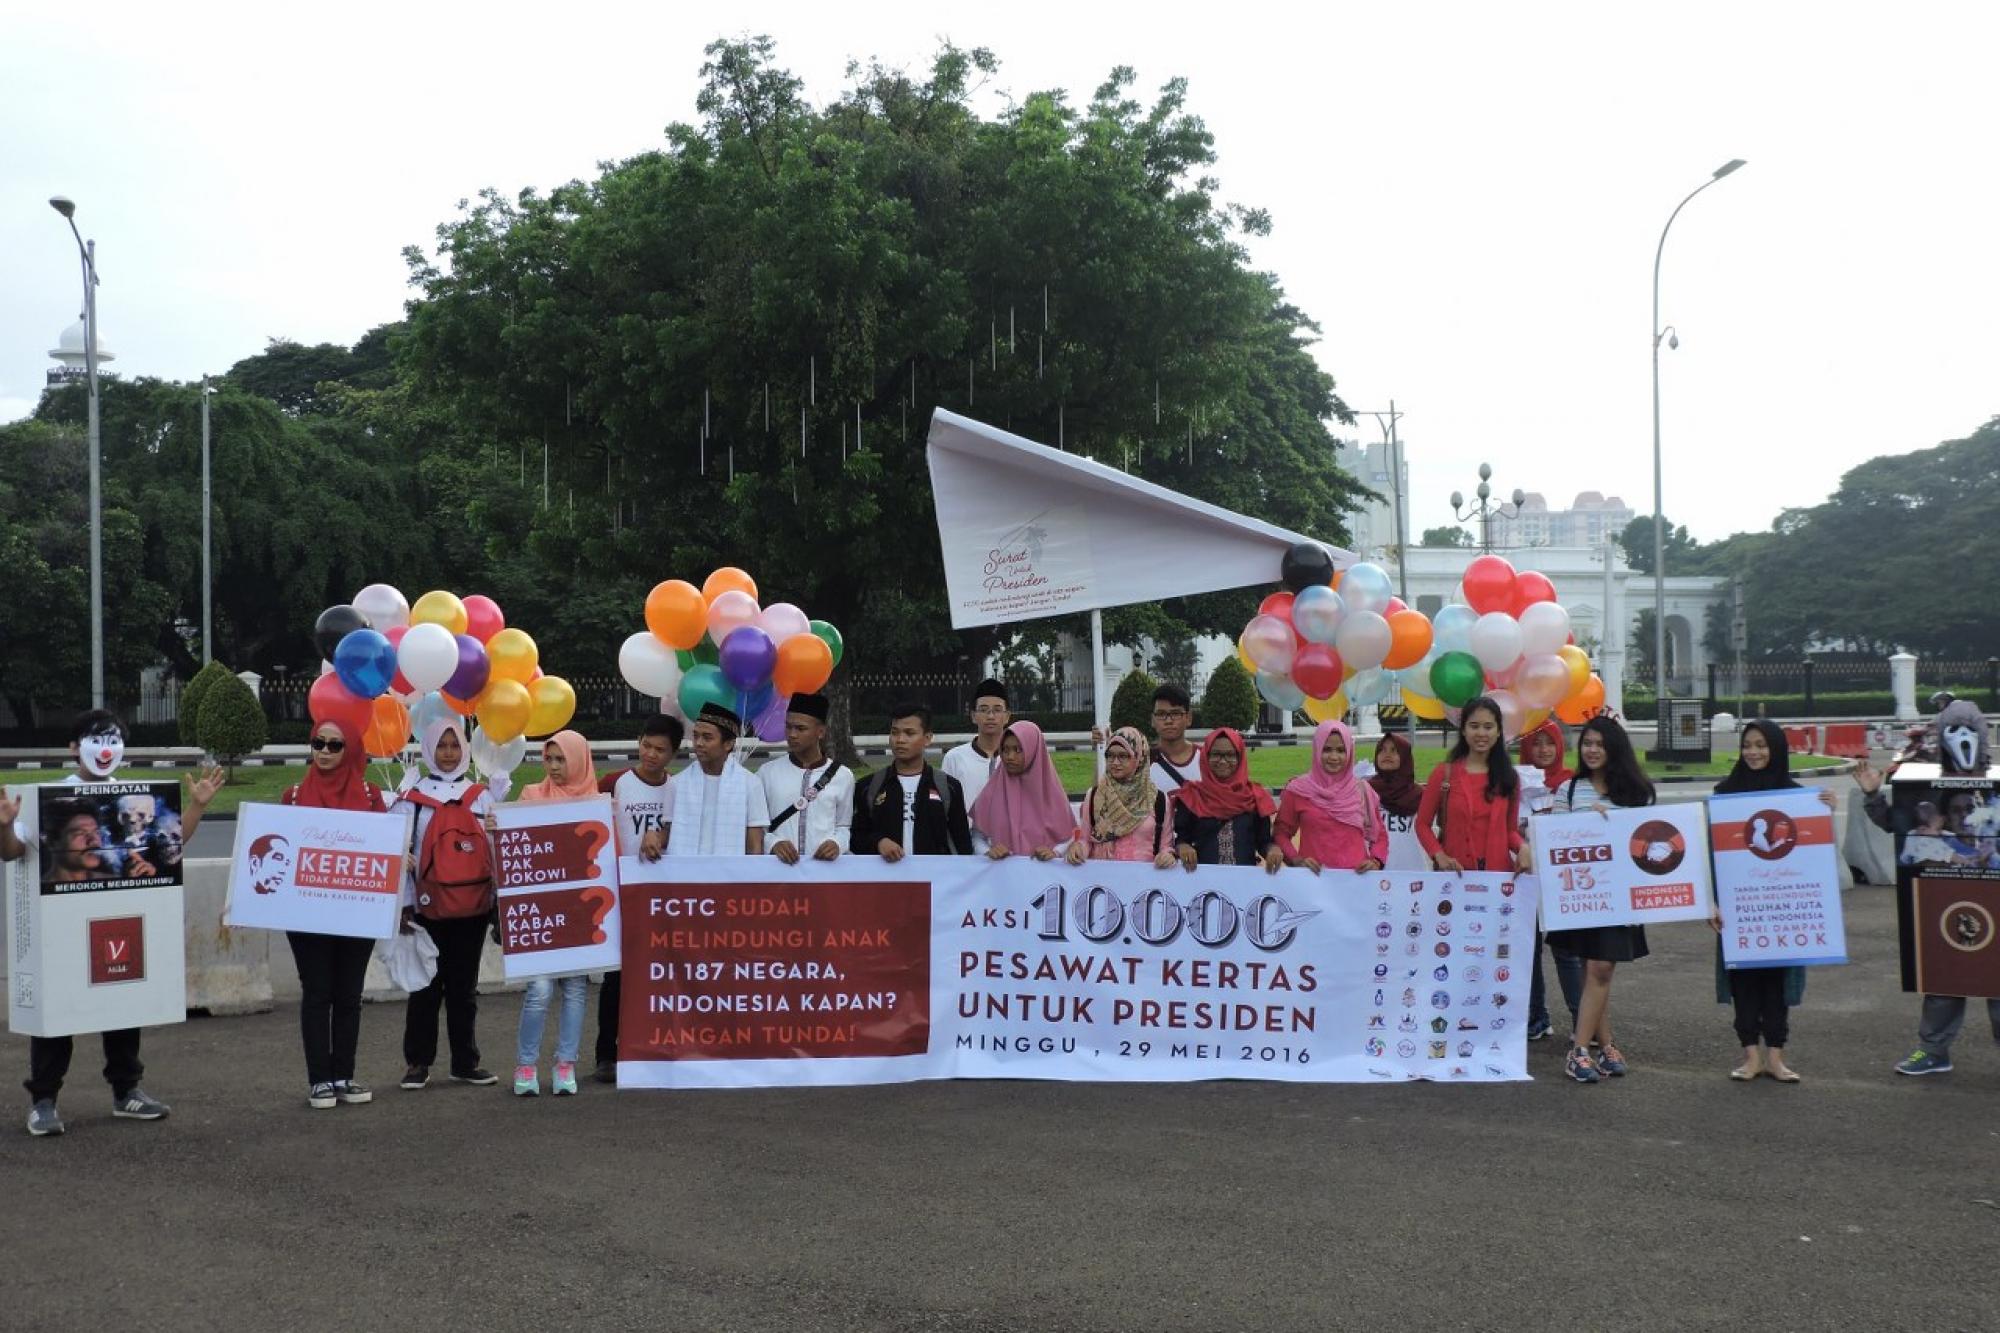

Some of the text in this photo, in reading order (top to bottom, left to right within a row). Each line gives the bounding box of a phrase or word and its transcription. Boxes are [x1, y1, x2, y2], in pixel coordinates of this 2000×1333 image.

[984, 549, 1028, 575] Surat
[983, 573, 1049, 593] Presiden
[74, 784, 150, 795] PERINGATAN
[500, 831, 531, 844] APA
[502, 841, 554, 857] KABAR
[1554, 846, 1608, 864] FCTC
[301, 852, 389, 879] KEREN
[503, 858, 532, 871] PAK
[55, 876, 174, 892] MEROKOK MEMBUNUHMU
[301, 874, 387, 890] TIDAK MEROKOK!
[504, 868, 567, 885] JOKOWI
[1558, 867, 1596, 892] 13
[1635, 886, 1688, 895] INDONESIA
[506, 902, 540, 918] APA
[651, 898, 810, 916] FCTC SUDAH
[1635, 895, 1690, 909] KAPAN?
[1736, 901, 1823, 913] PULUHAN JUTA
[508, 914, 566, 932] KABAR
[960, 884, 1300, 952] AKSI 10.000
[1737, 913, 1824, 923] ANAK INDONESIA
[509, 931, 553, 948] FCTC
[651, 929, 891, 949] MELINDUNGI ANAK
[1738, 933, 1826, 949] ROKOK
[651, 962, 846, 982] DI 187 NEGARA,
[960, 951, 1318, 992] PESAWAT KERTAS
[650, 992, 897, 1013] INDONESIA KAPAN?
[958, 992, 1315, 1032] UNTUK PRESIDEN
[649, 1025, 857, 1045] JANGAN TUNDA!
[955, 1034, 1077, 1054] MINGGU
[1119, 1041, 1151, 1057] 29
[1171, 1045, 1222, 1059] MEI
[1240, 1046, 1311, 1064] 2016
